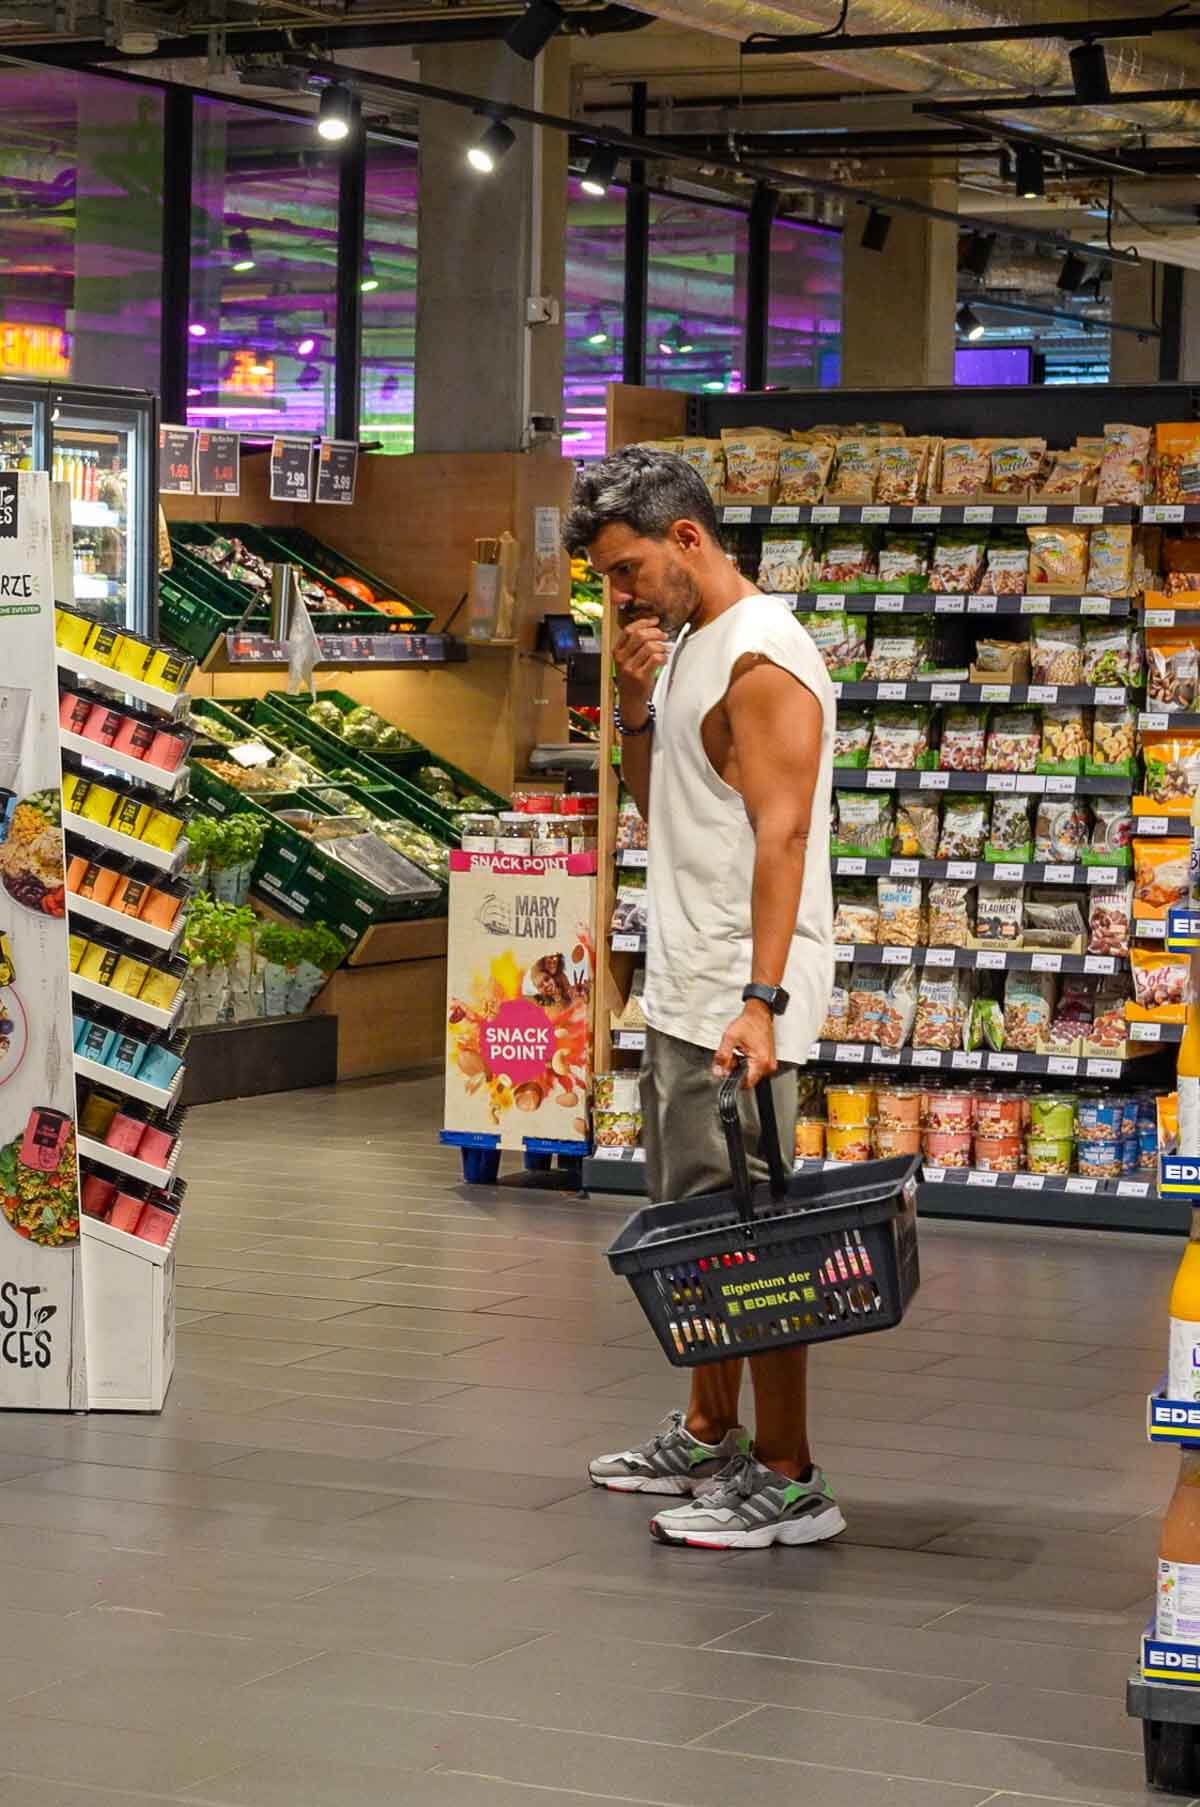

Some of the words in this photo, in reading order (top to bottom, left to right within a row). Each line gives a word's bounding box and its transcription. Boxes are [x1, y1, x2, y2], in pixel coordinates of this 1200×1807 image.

[470, 854, 522, 870] SNACK
[524, 857, 568, 870] POINT
[515, 895, 560, 918] MARY
[515, 917, 557, 938] LAND
[486, 1027, 549, 1044] SNACK
[490, 1044, 546, 1060] POINT
[721, 1276, 785, 1297] Eigentum
[788, 1271, 812, 1284] der
[743, 1290, 801, 1310] EDEKA
[2, 1330, 52, 1368] CES
